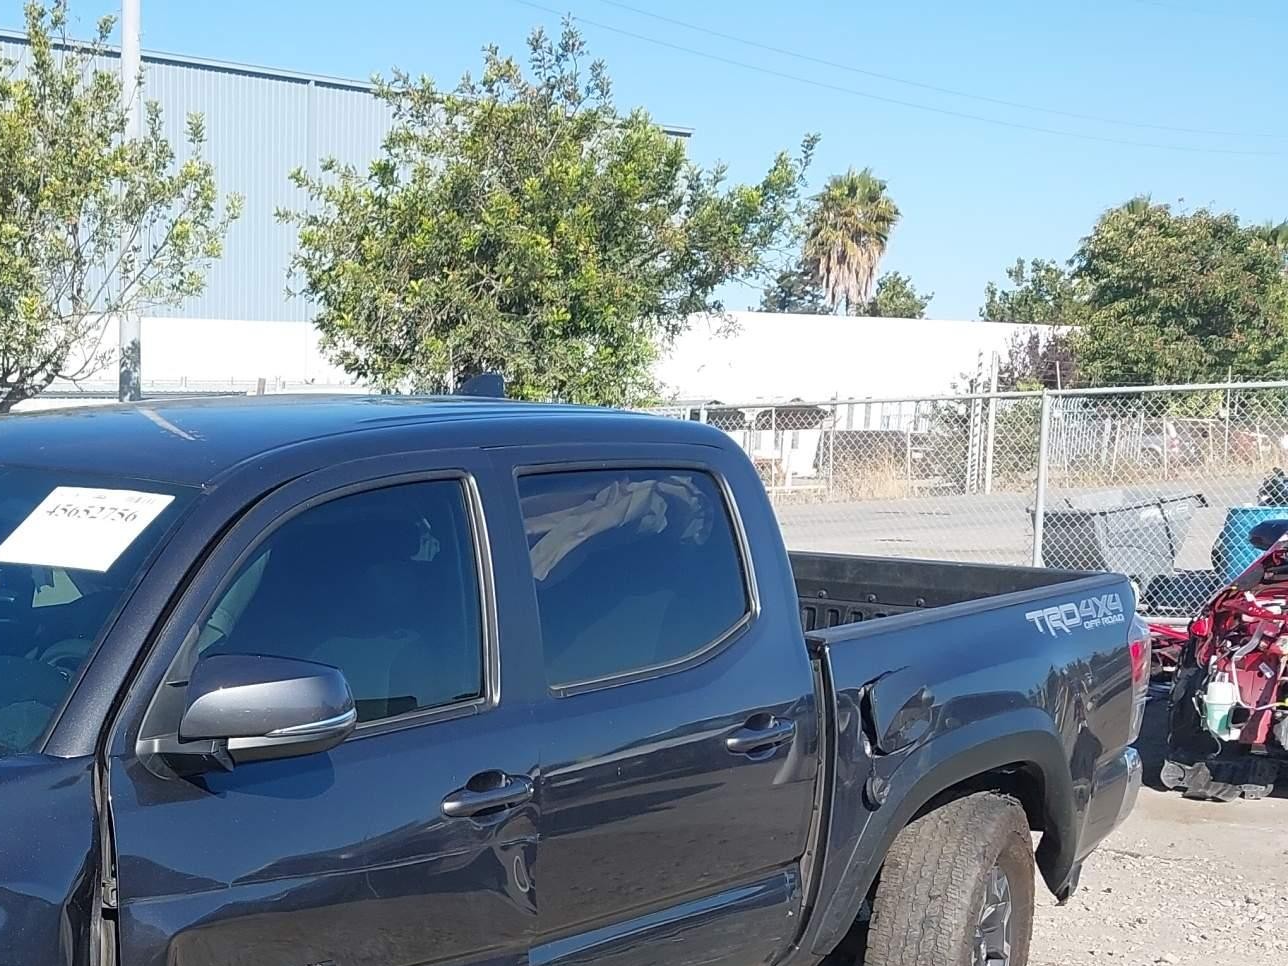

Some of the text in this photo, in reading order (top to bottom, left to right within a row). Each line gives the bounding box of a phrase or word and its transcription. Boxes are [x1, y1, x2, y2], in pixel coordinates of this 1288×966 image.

[46, 503, 138, 523] 45652756
[1025, 593, 1124, 639] TRD 4X4
[1083, 613, 1125, 630] OFF ROAD
